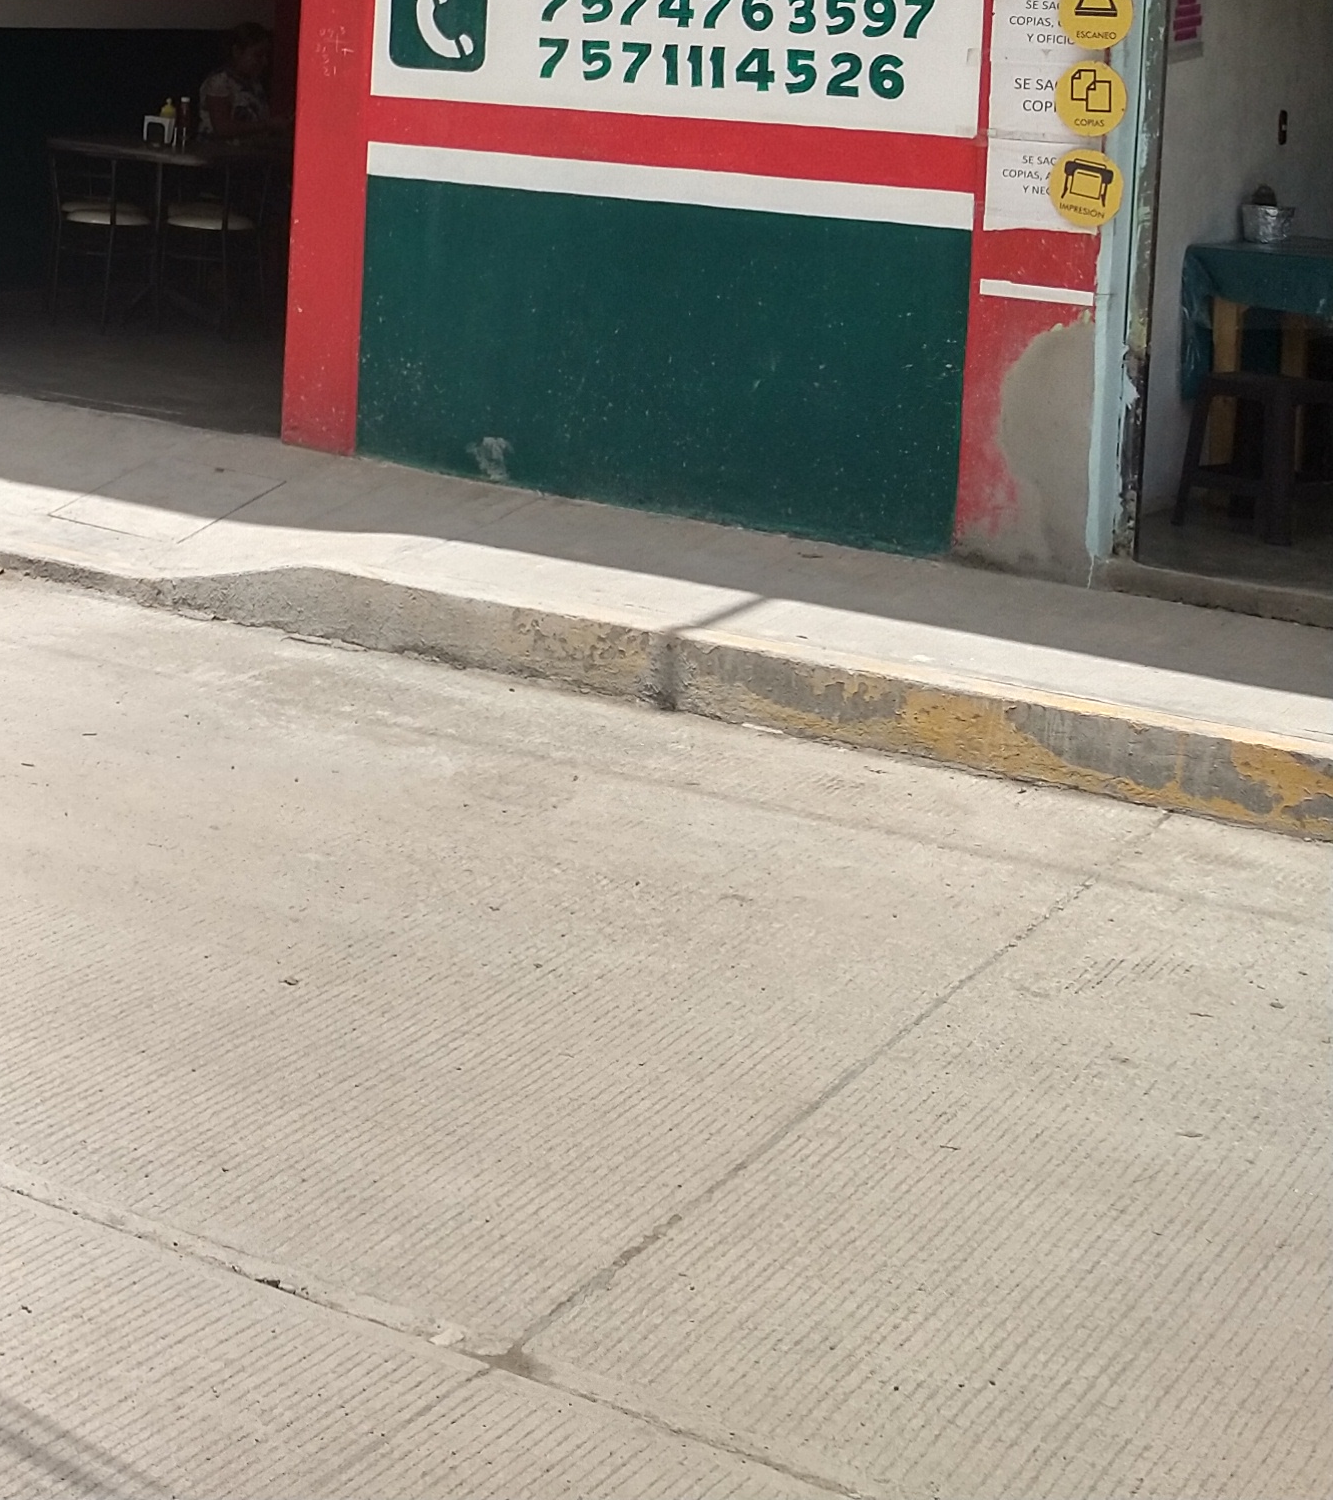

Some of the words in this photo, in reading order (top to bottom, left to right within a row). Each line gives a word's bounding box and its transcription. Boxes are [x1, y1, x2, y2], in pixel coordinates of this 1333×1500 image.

[1025, 0, 1039, 11] SE
[1009, 15, 1055, 28] COPIAS,
[1027, 32, 1033, 44] Y
[1075, 29, 1117, 41] ESCANEO
[538, 37, 907, 101] 7571114526
[1014, 77, 1031, 91] SE
[1035, 77, 1058, 92] SA
[1073, 117, 1105, 128] COPIAS
[1022, 154, 1035, 165] SE
[1022, 185, 1029, 195] Y
[1059, 201, 1106, 220] IMPRESIÓN
